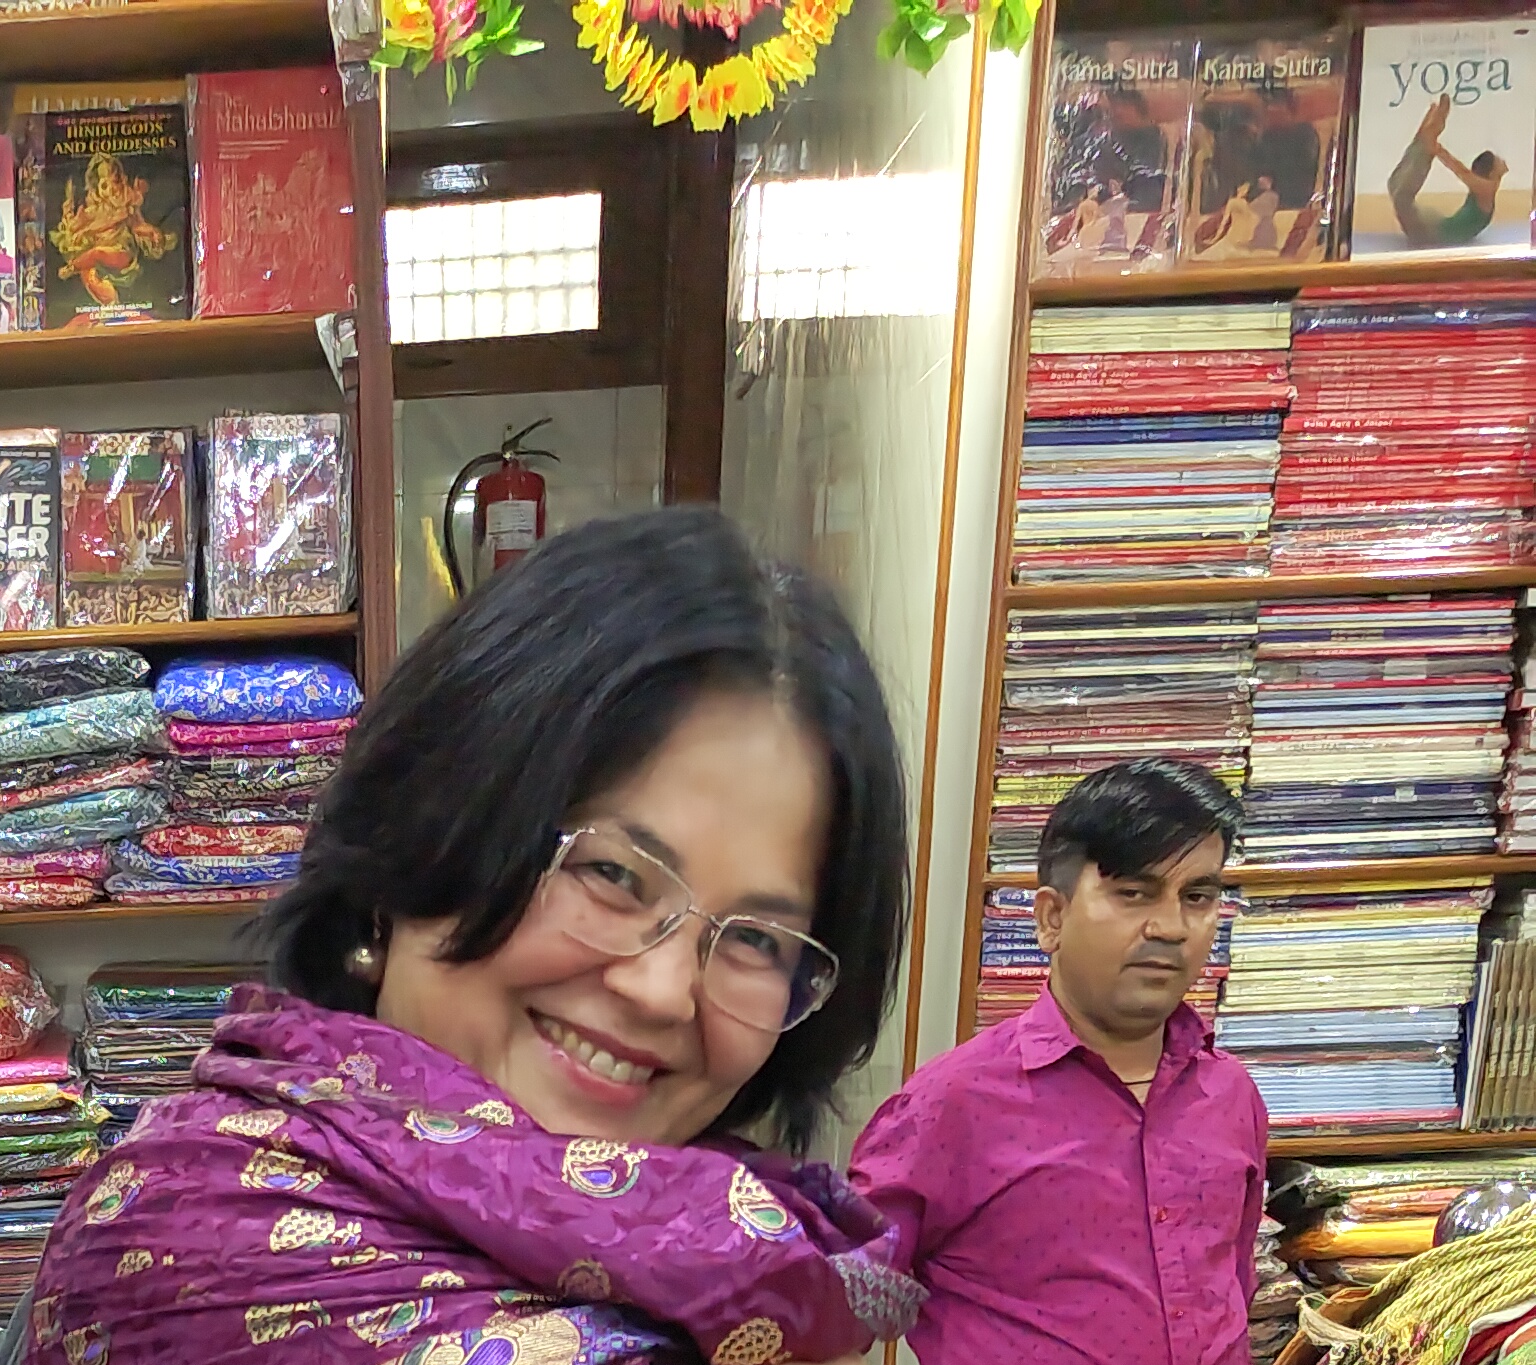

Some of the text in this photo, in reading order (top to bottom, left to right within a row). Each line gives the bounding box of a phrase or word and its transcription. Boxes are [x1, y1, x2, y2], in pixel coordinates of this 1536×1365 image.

[1056, 54, 1179, 82] Kama Sutra
[1203, 54, 1332, 82] Kama Sutra
[1389, 58, 1511, 107] yoga
[66, 122, 118, 139] HINDU
[120, 120, 164, 136] GODS
[53, 141, 87, 155] AND
[89, 136, 177, 153] GODDESSES
